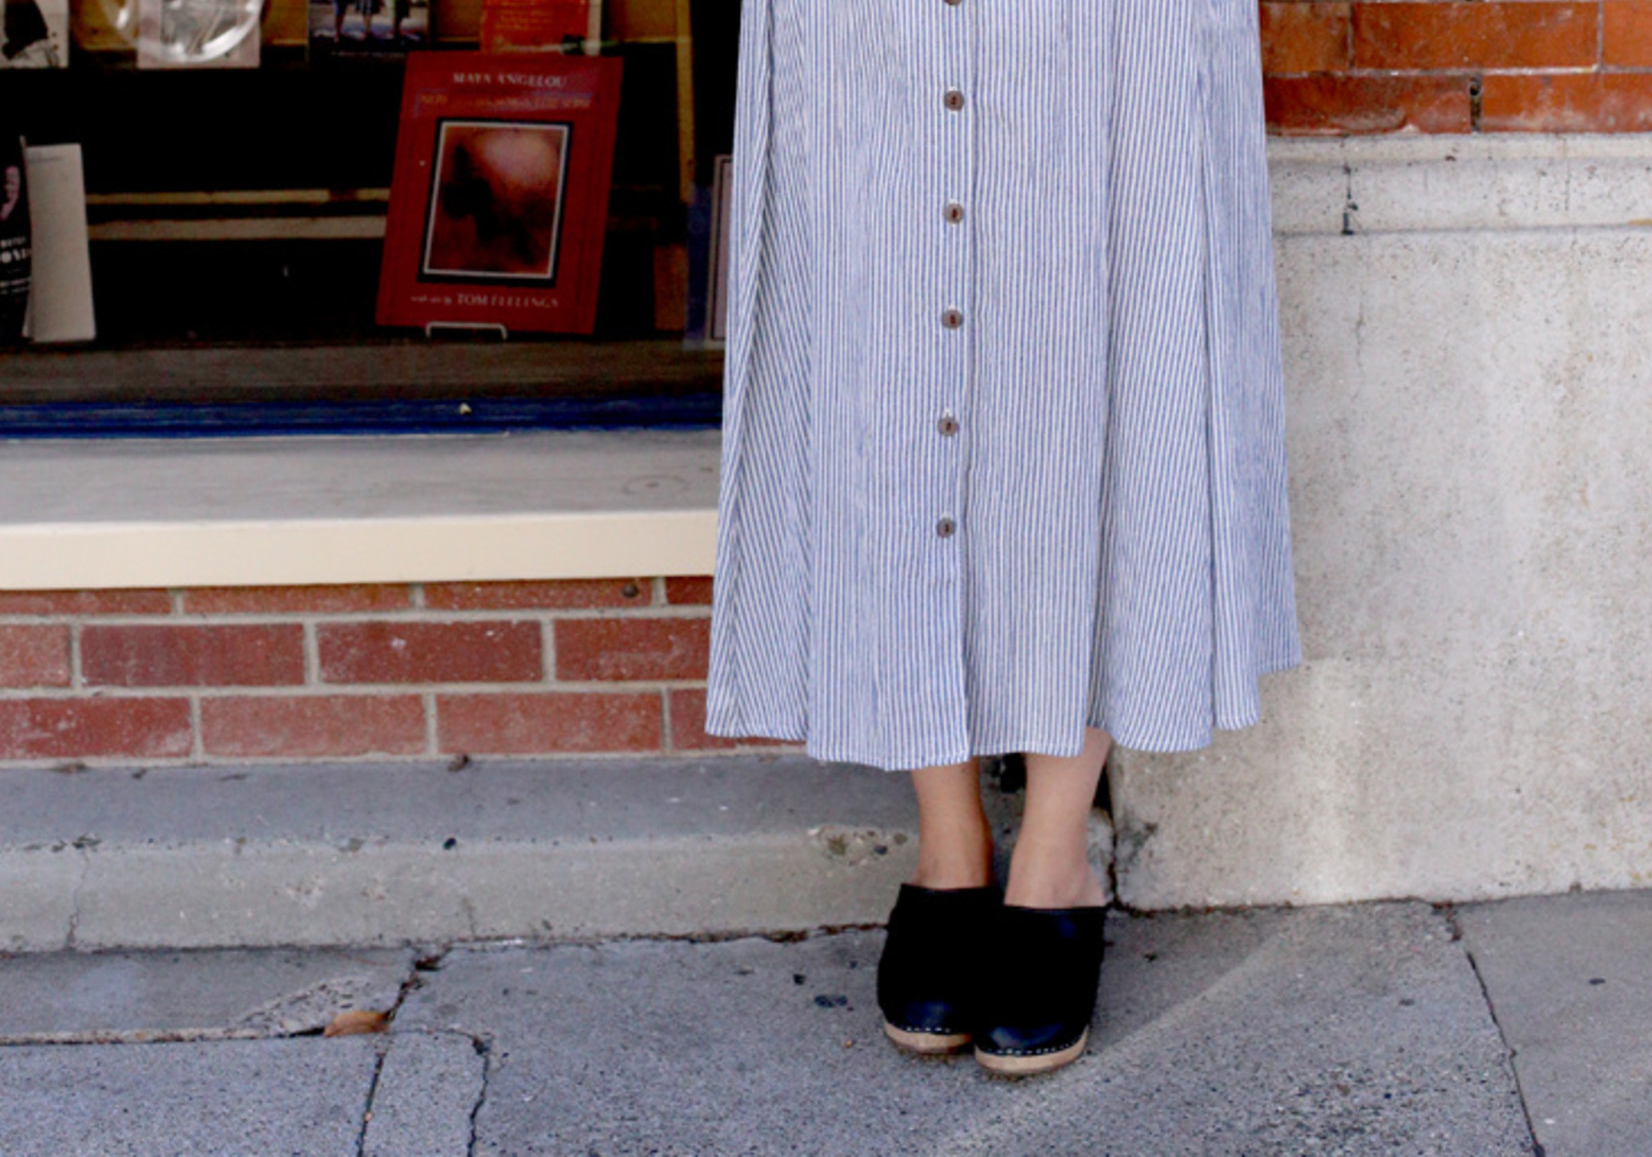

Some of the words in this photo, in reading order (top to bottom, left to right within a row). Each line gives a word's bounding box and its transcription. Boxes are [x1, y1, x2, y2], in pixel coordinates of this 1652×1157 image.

[453, 72, 492, 85] MAYA
[497, 73, 567, 88] ANGELOU
[457, 292, 488, 306] TOM
